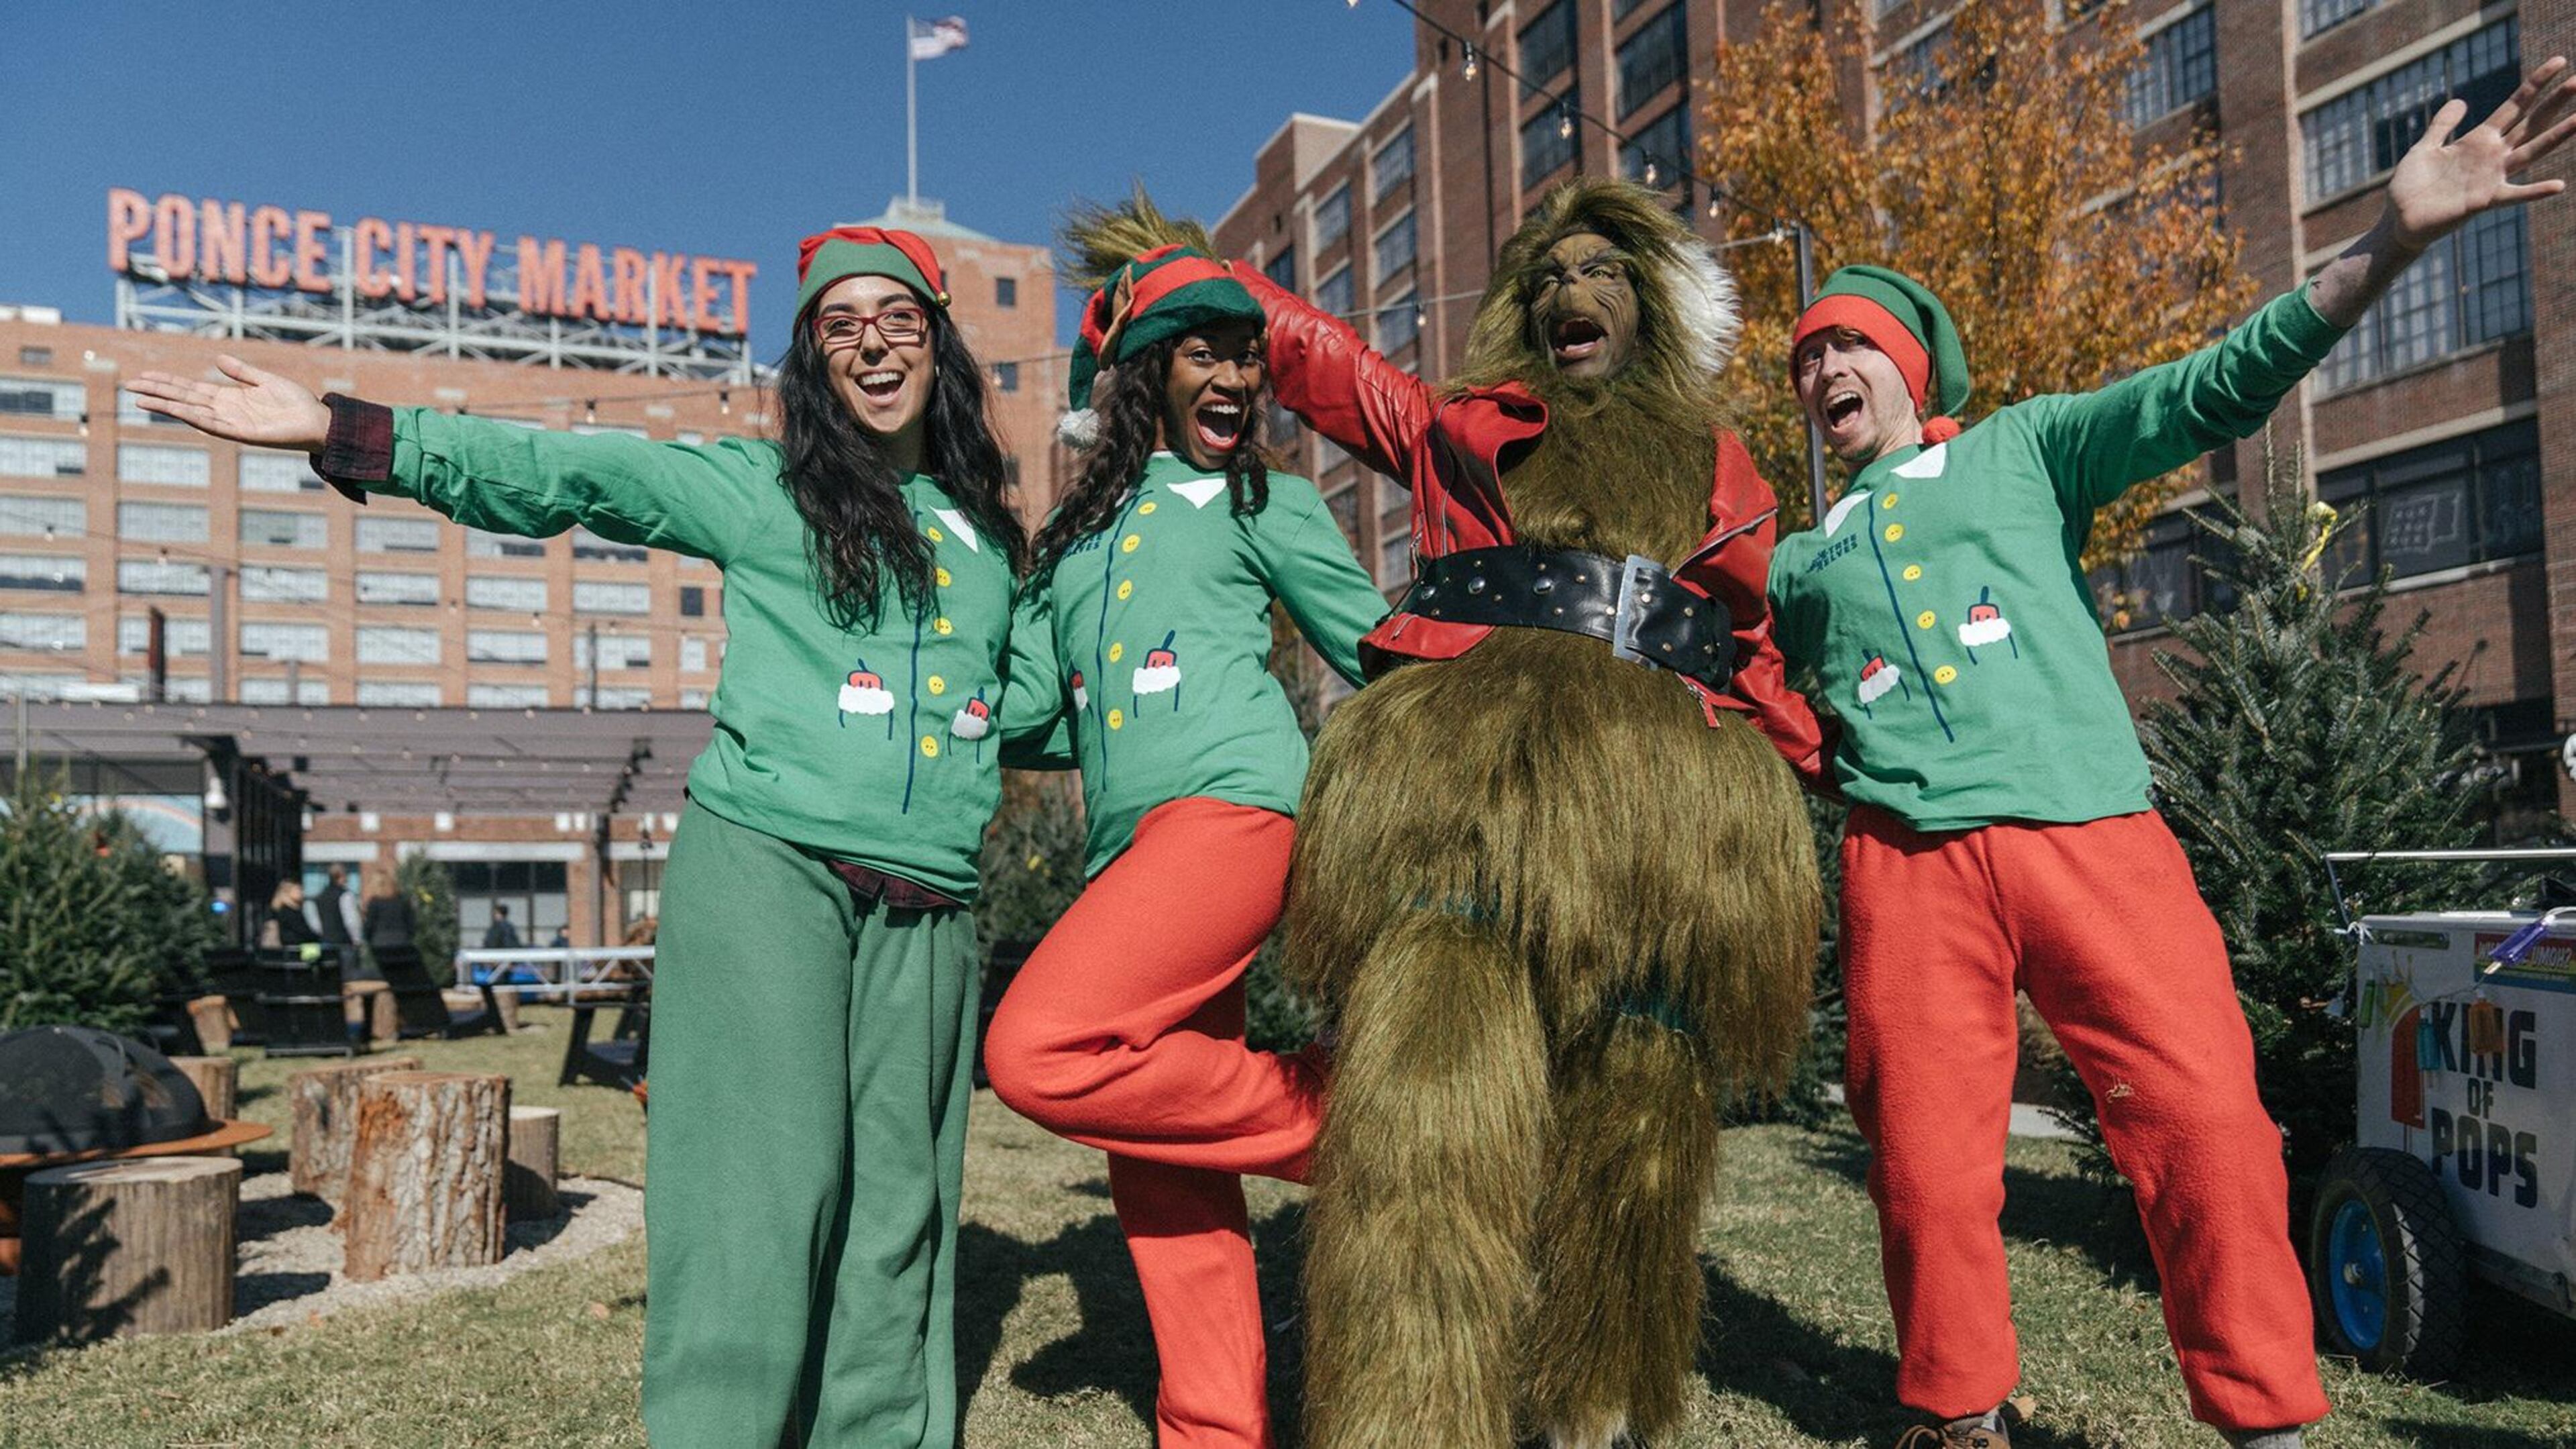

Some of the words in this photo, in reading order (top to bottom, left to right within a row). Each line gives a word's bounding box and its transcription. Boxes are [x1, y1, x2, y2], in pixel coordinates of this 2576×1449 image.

[107, 186, 332, 292] PONCE
[356, 216, 495, 309] CITY
[517, 235, 757, 334] MARKET
[2432, 1002, 2536, 1089] KING
[2467, 1077, 2493, 1119] OF
[2432, 1107, 2537, 1209] POPS
